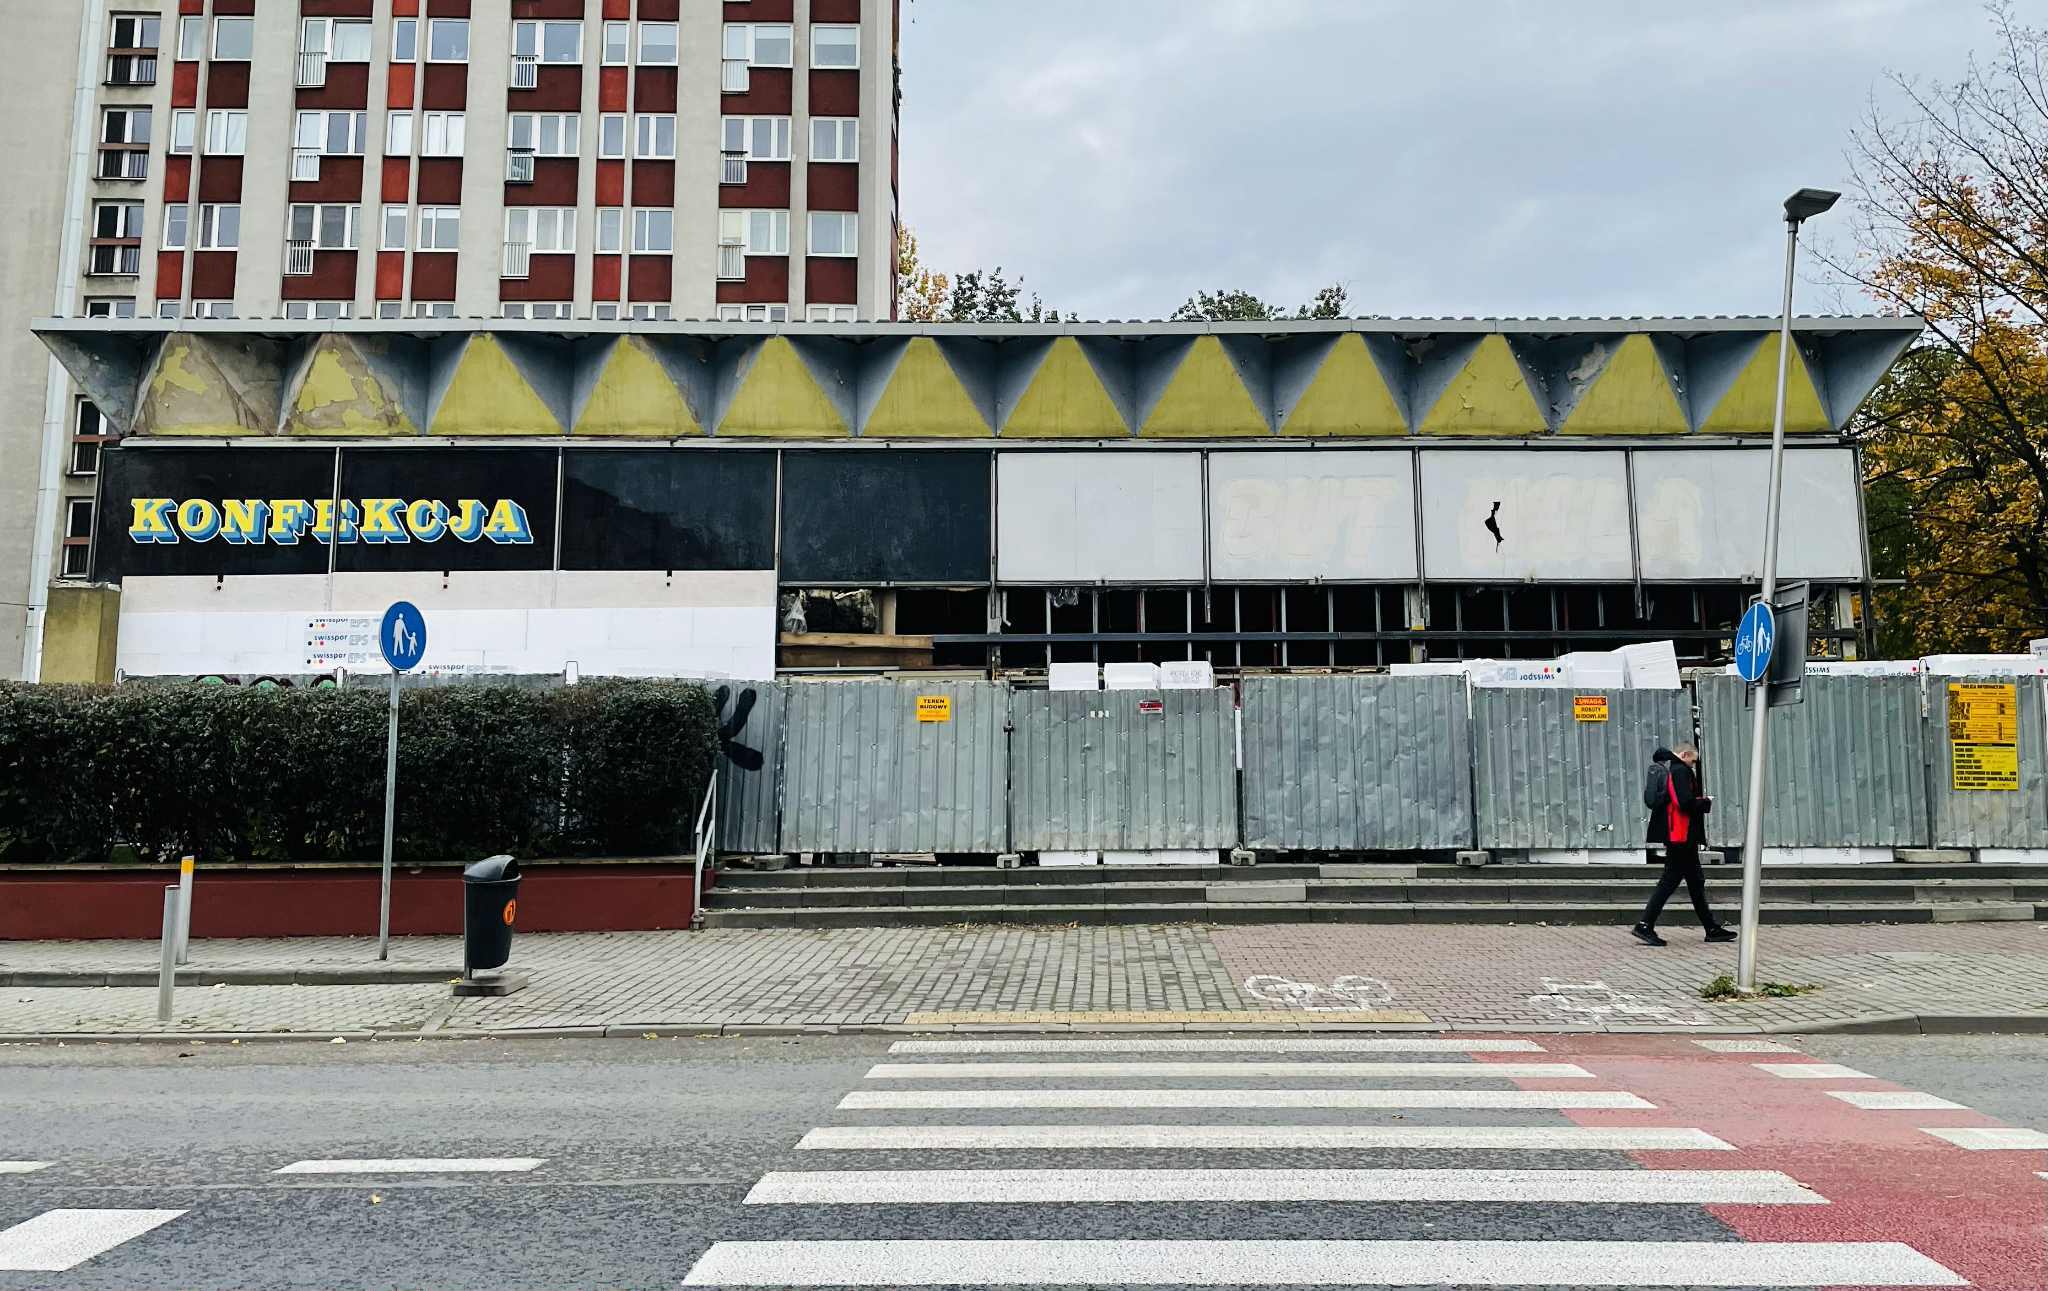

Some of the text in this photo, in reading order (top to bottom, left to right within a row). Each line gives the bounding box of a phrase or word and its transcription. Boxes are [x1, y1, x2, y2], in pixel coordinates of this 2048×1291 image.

[128, 498, 534, 545] KONFEKCJA
[428, 663, 465, 671] swisspor
[1520, 673, 1555, 681] swisspor
